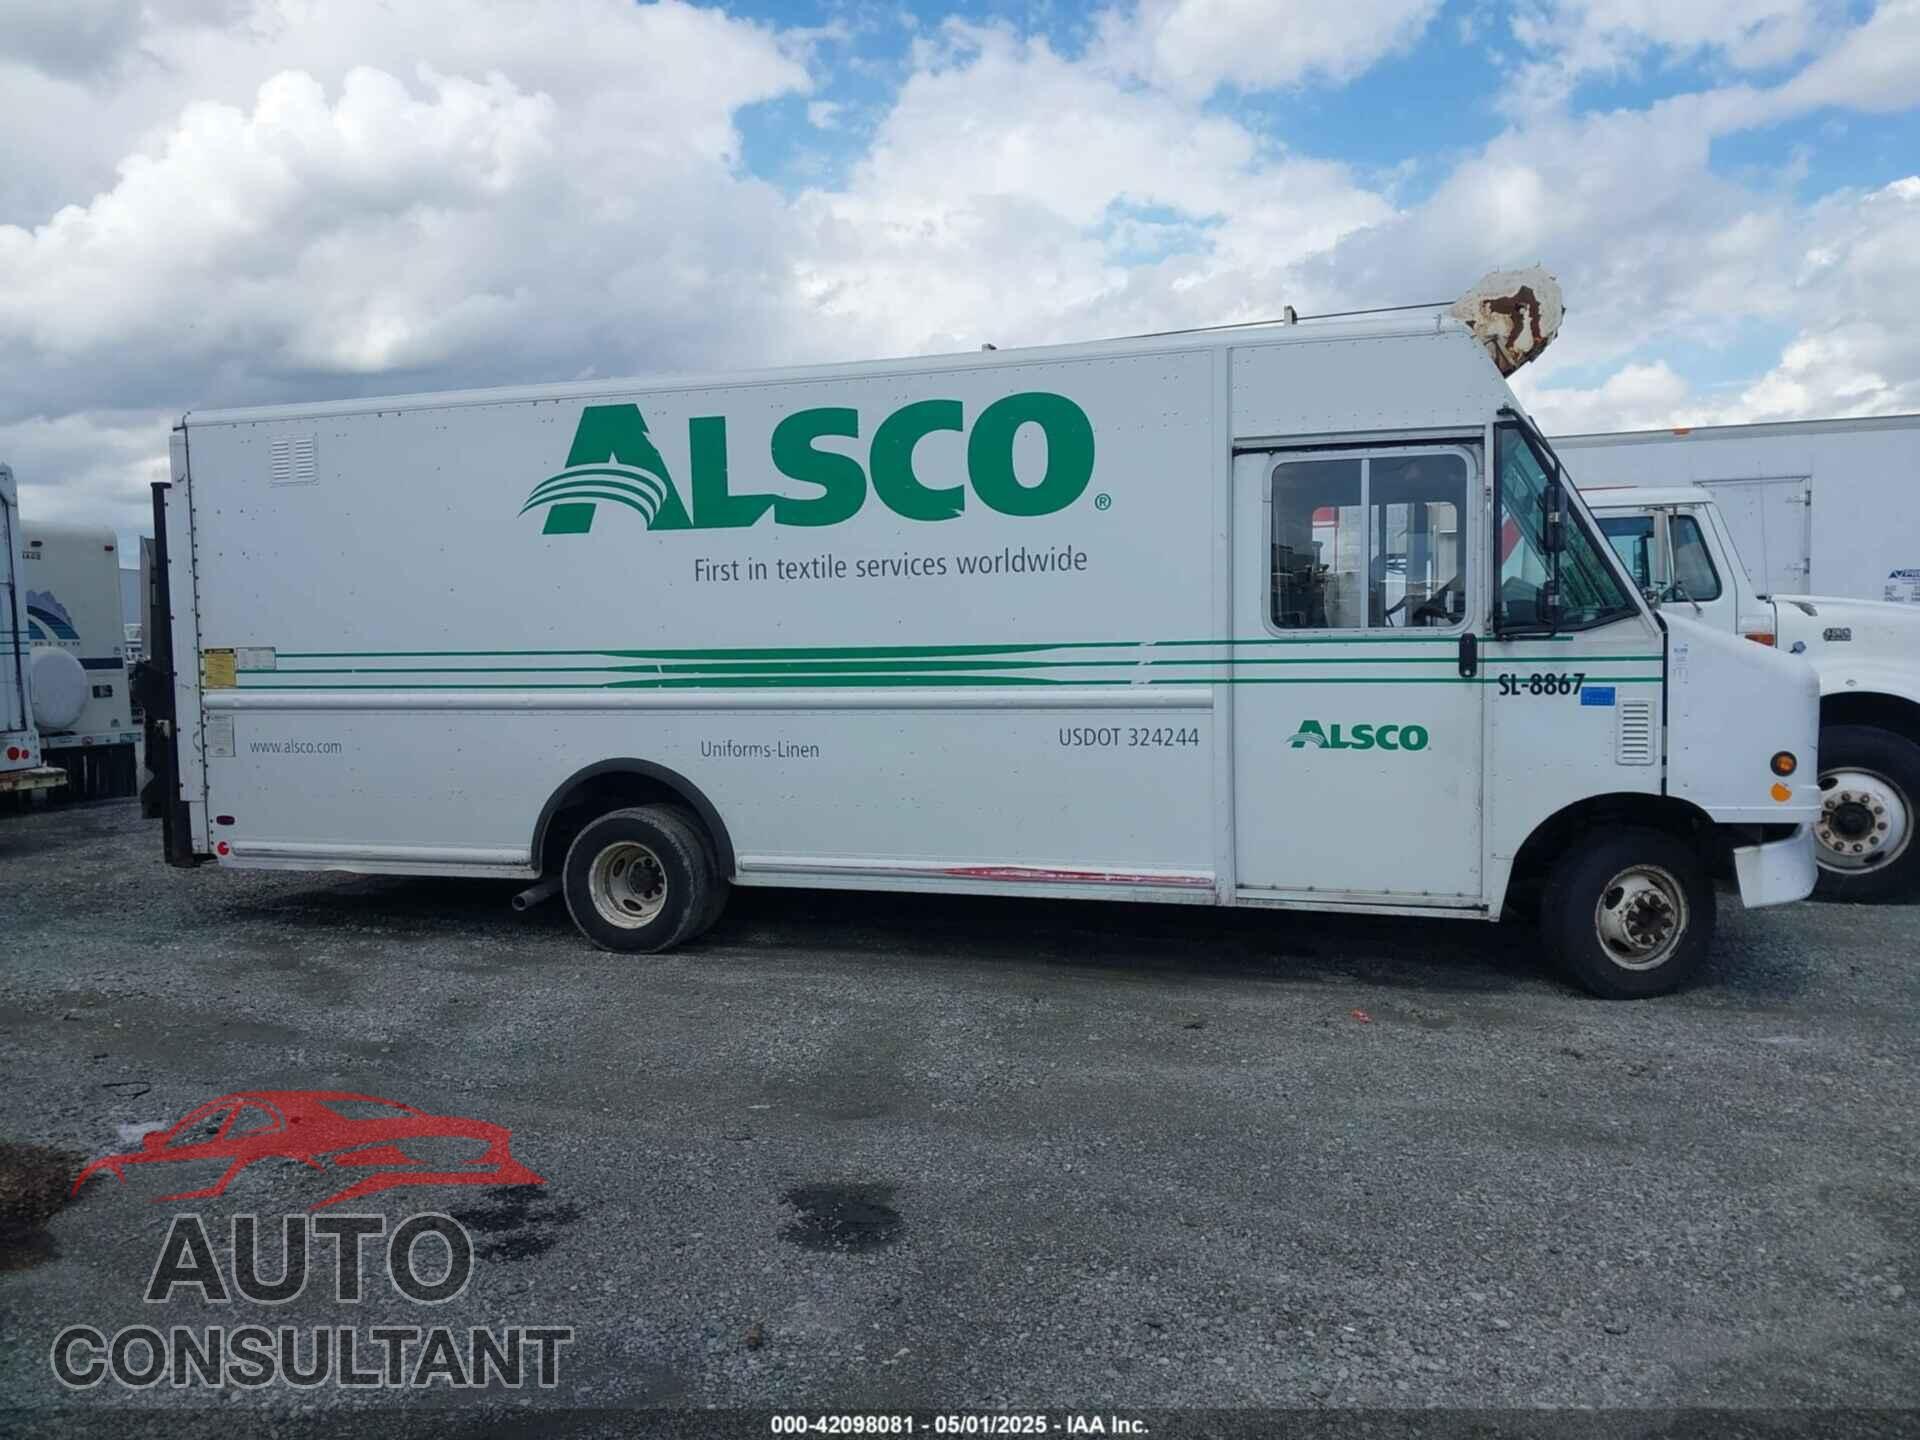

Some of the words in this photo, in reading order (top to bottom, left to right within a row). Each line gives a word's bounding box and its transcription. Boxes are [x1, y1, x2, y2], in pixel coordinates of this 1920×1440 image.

[520, 391, 1096, 535] ALSCO
[694, 557, 740, 582] First
[747, 556, 768, 580] in
[776, 553, 848, 580] textile
[855, 551, 947, 577] services
[956, 544, 1088, 574] worldwide
[1498, 672, 1586, 696] SL-8867
[250, 738, 342, 754] www.alsco.com
[1058, 728, 1121, 747] USDOT
[1127, 728, 1200, 747] 324244
[1288, 719, 1429, 751] ALSCO
[700, 740, 820, 759] Uniforms-Linen
